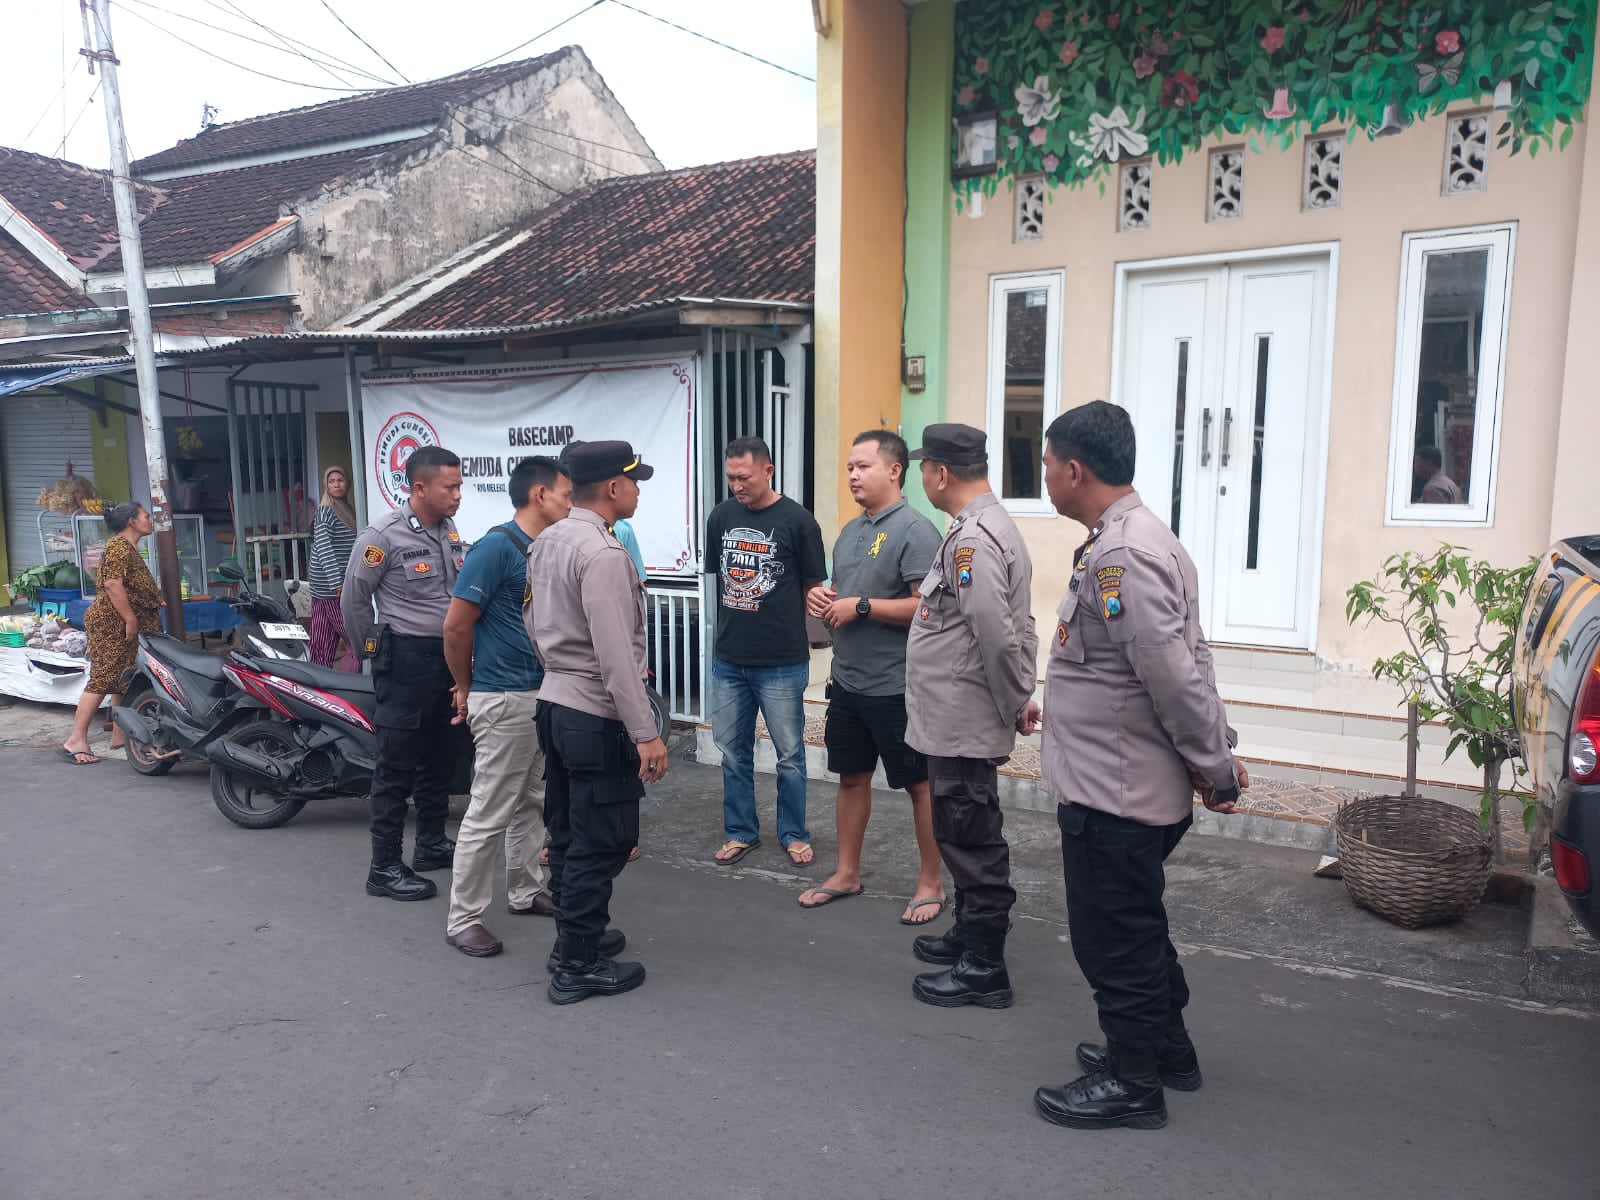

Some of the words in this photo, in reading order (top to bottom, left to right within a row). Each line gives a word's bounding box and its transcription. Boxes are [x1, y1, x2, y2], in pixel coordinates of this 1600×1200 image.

[401, 421, 433, 446] CUNGKI
[508, 425, 574, 447] BASECAMP
[459, 456, 503, 477] EMUDA
